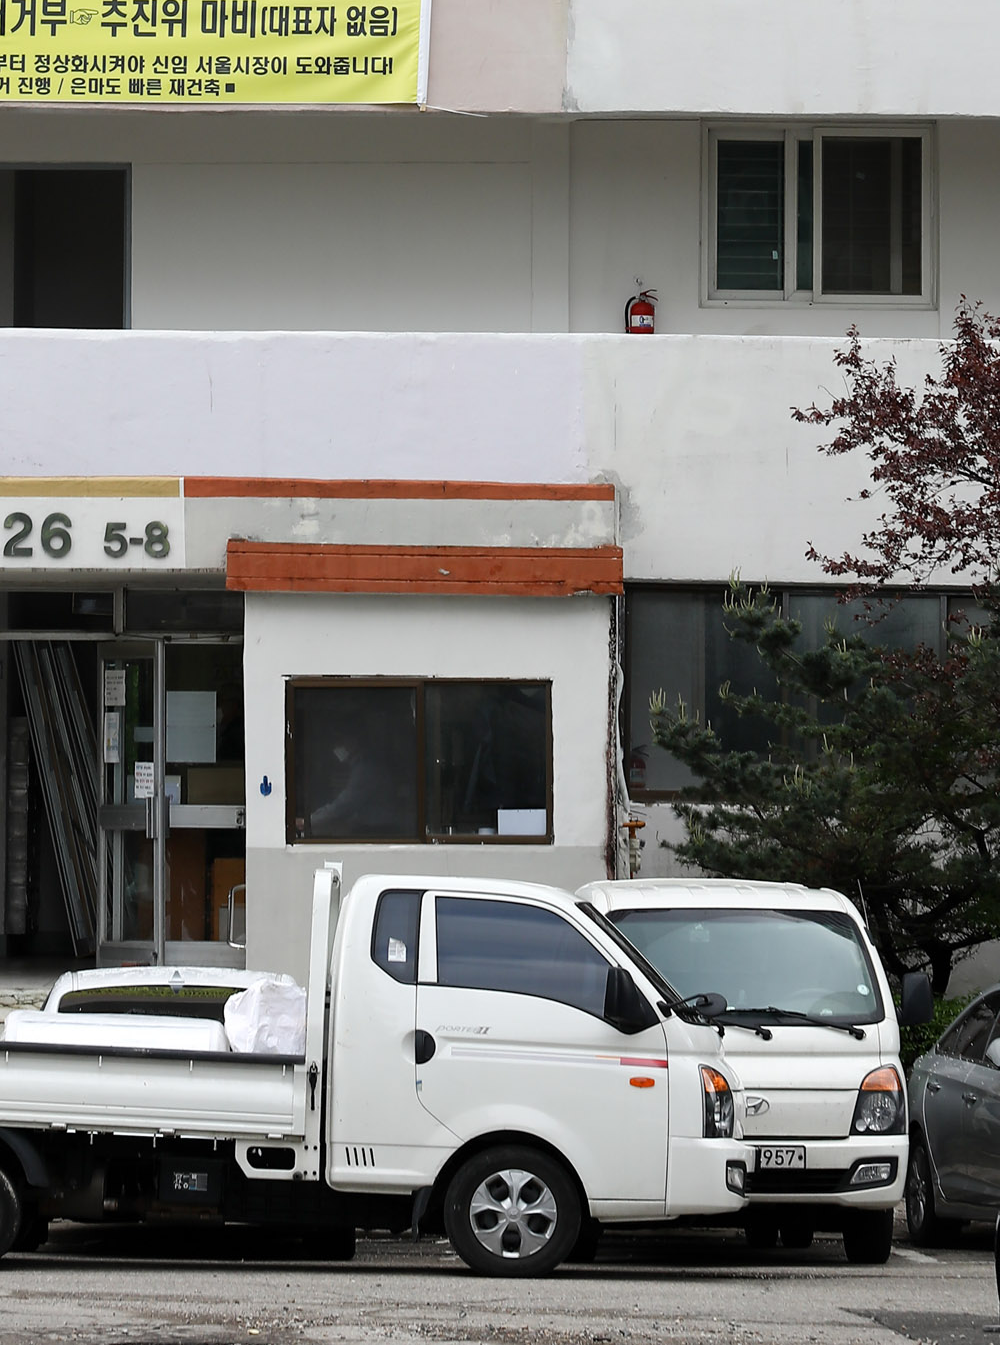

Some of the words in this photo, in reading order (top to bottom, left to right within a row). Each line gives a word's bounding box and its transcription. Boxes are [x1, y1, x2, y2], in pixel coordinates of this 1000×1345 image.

[347, 6, 397, 36] 없음)
[34, 55, 145, 74] 정상화시켜야
[152, 56, 187, 74] 신임
[196, 56, 287, 75] 서울시장이
[296, 57, 392, 75] 도와줍니다!
[18, 77, 50, 95] 진행
[71, 78, 121, 95] 은마도
[129, 79, 162, 95] 빠른
[169, 79, 220, 96] 재건축
[3, 512, 72, 559] 26
[104, 521, 170, 559] 5-8
